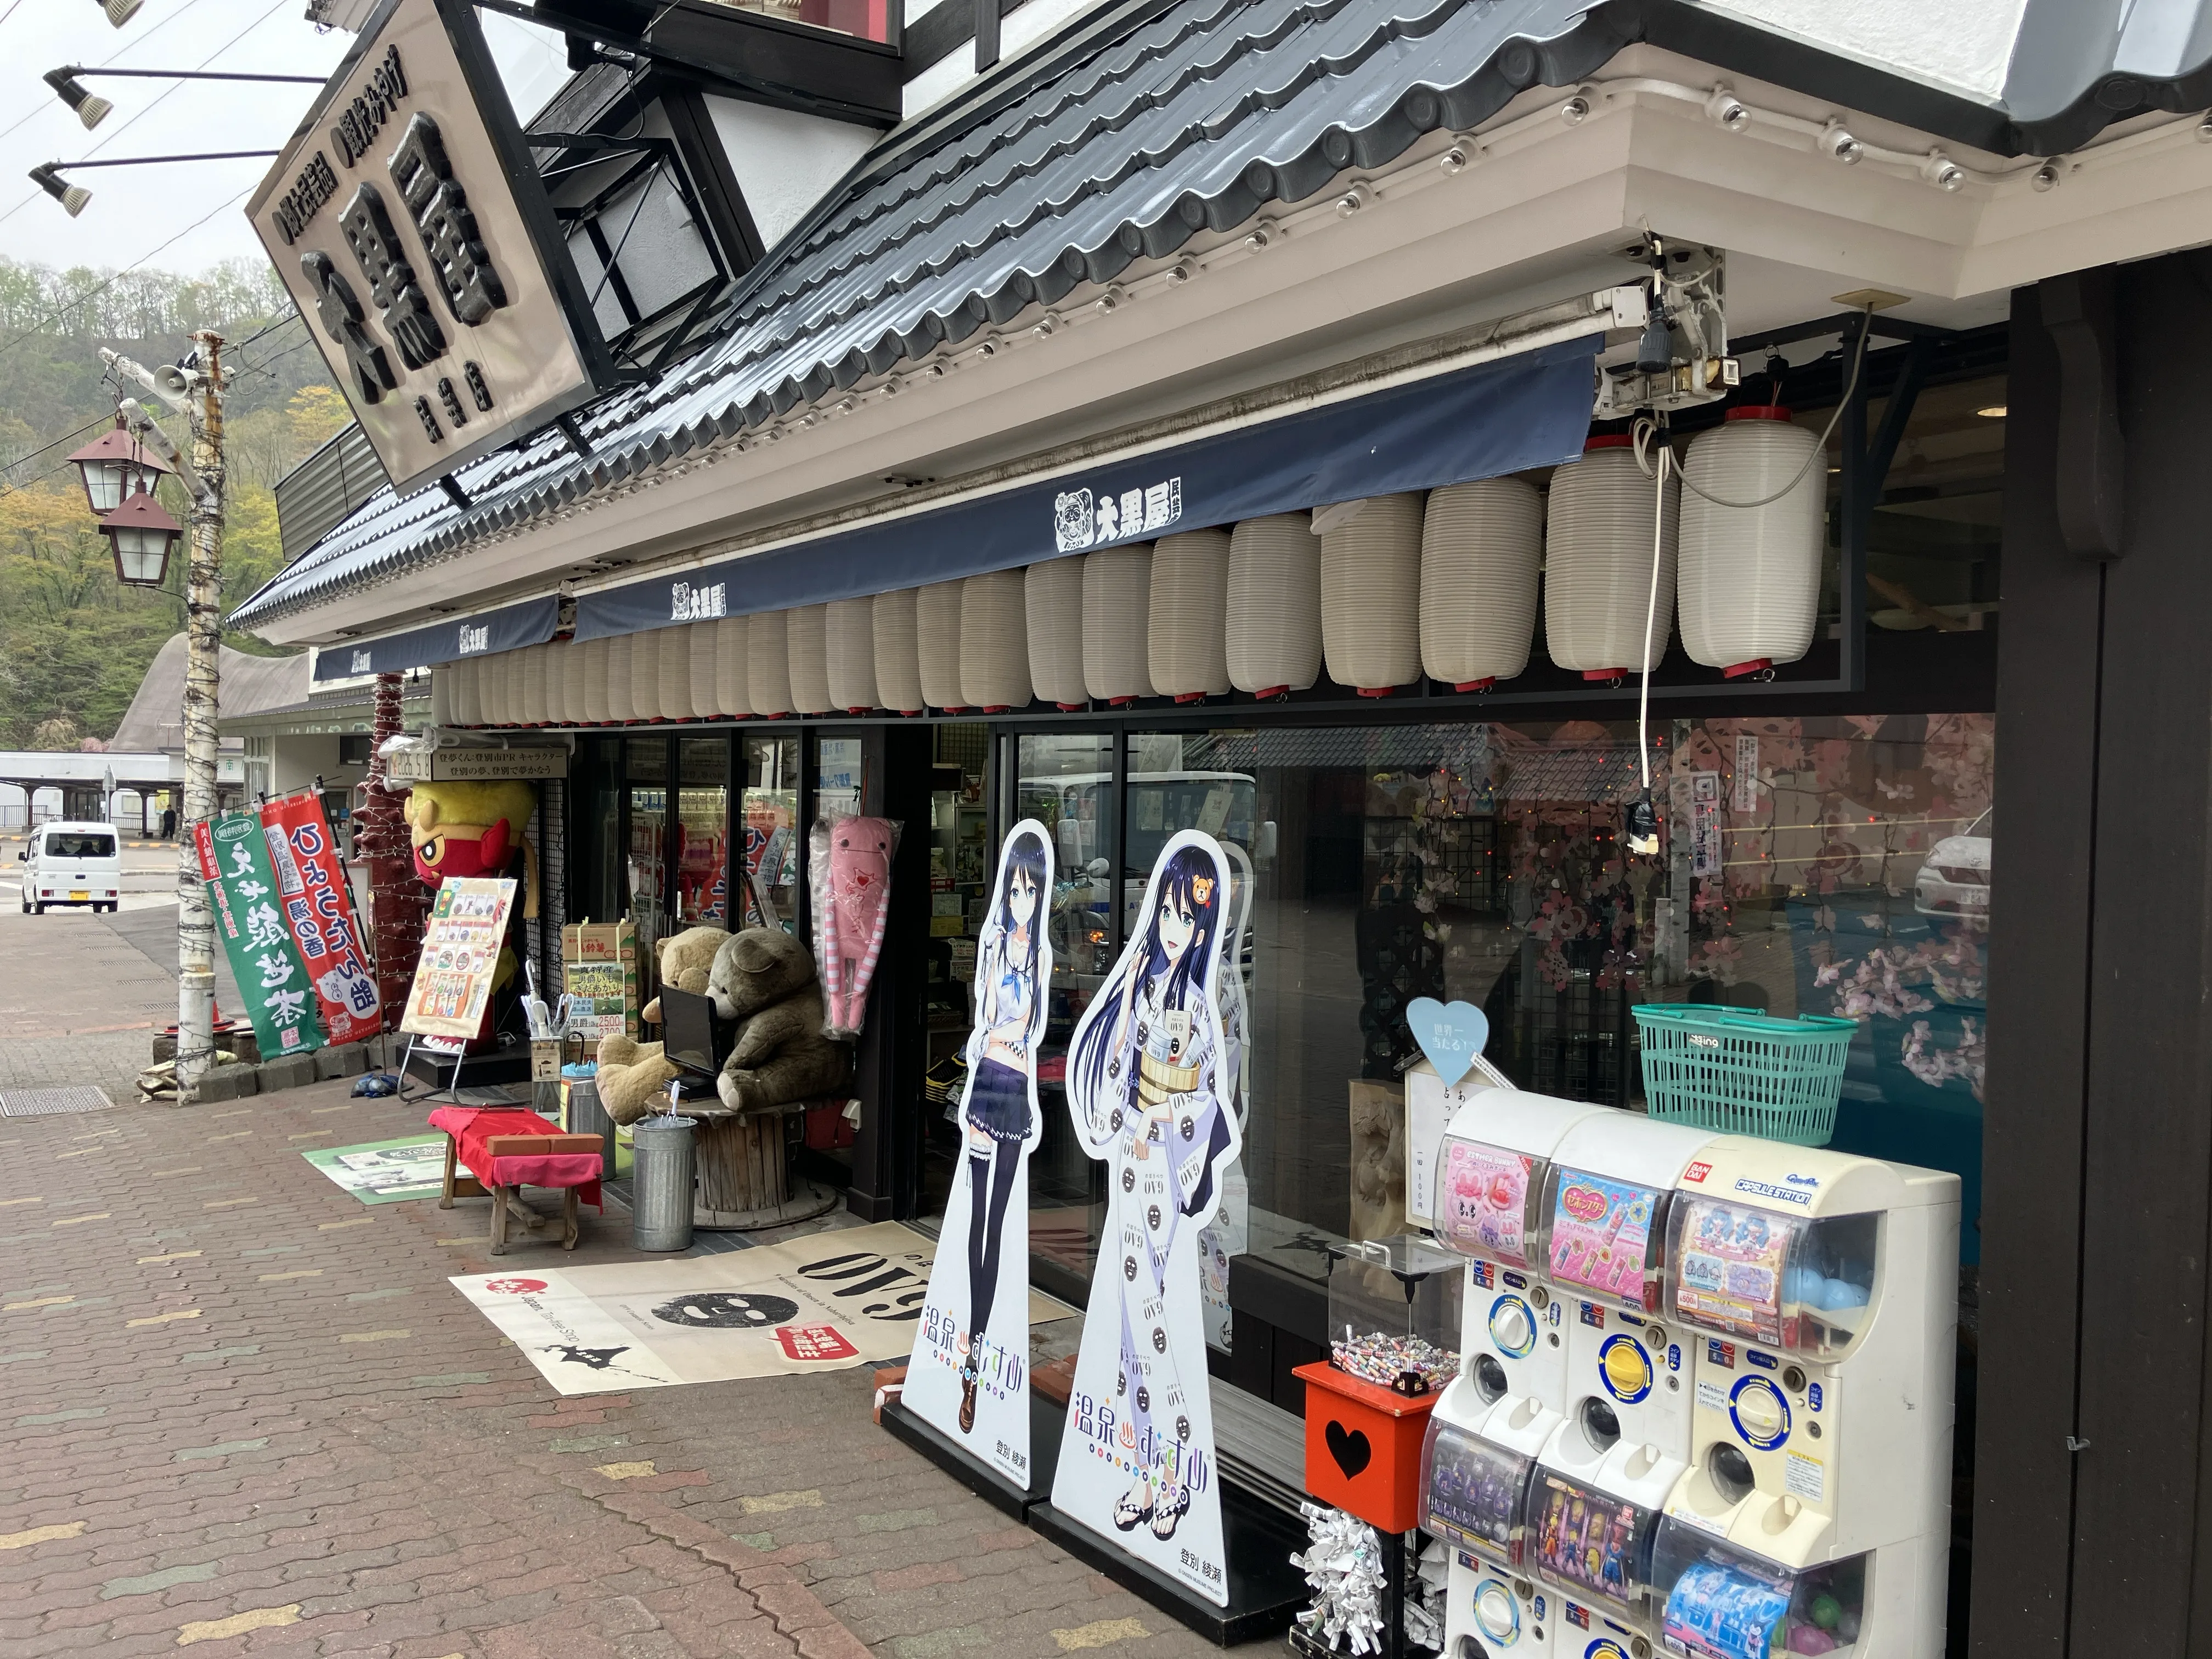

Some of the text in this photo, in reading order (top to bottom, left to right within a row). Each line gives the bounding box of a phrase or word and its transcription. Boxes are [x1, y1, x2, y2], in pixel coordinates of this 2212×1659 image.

[301, 111, 507, 405] 大黒屋
[1096, 481, 1170, 544] 大黒屋
[690, 583, 721, 619] 大黒屋
[519, 753, 563, 761] キャラクター
[450, 766, 551, 777] 登別の夢、登別で夢かなう
[579, 974, 614, 983] 男爵いも
[1434, 1023, 1464, 1037] 世界一
[1686, 1169, 1701, 1179] DAI
[1690, 1164, 1709, 1173] BAN
[1567, 1192, 1604, 1214] セボンスター
[825, 1305, 856, 1326] Noboribetsu
[560, 1324, 580, 1342] Shop
[996, 1439, 1026, 1471] 登別 綾瀬
[1180, 1547, 1222, 1585] 登別 綾瀬
